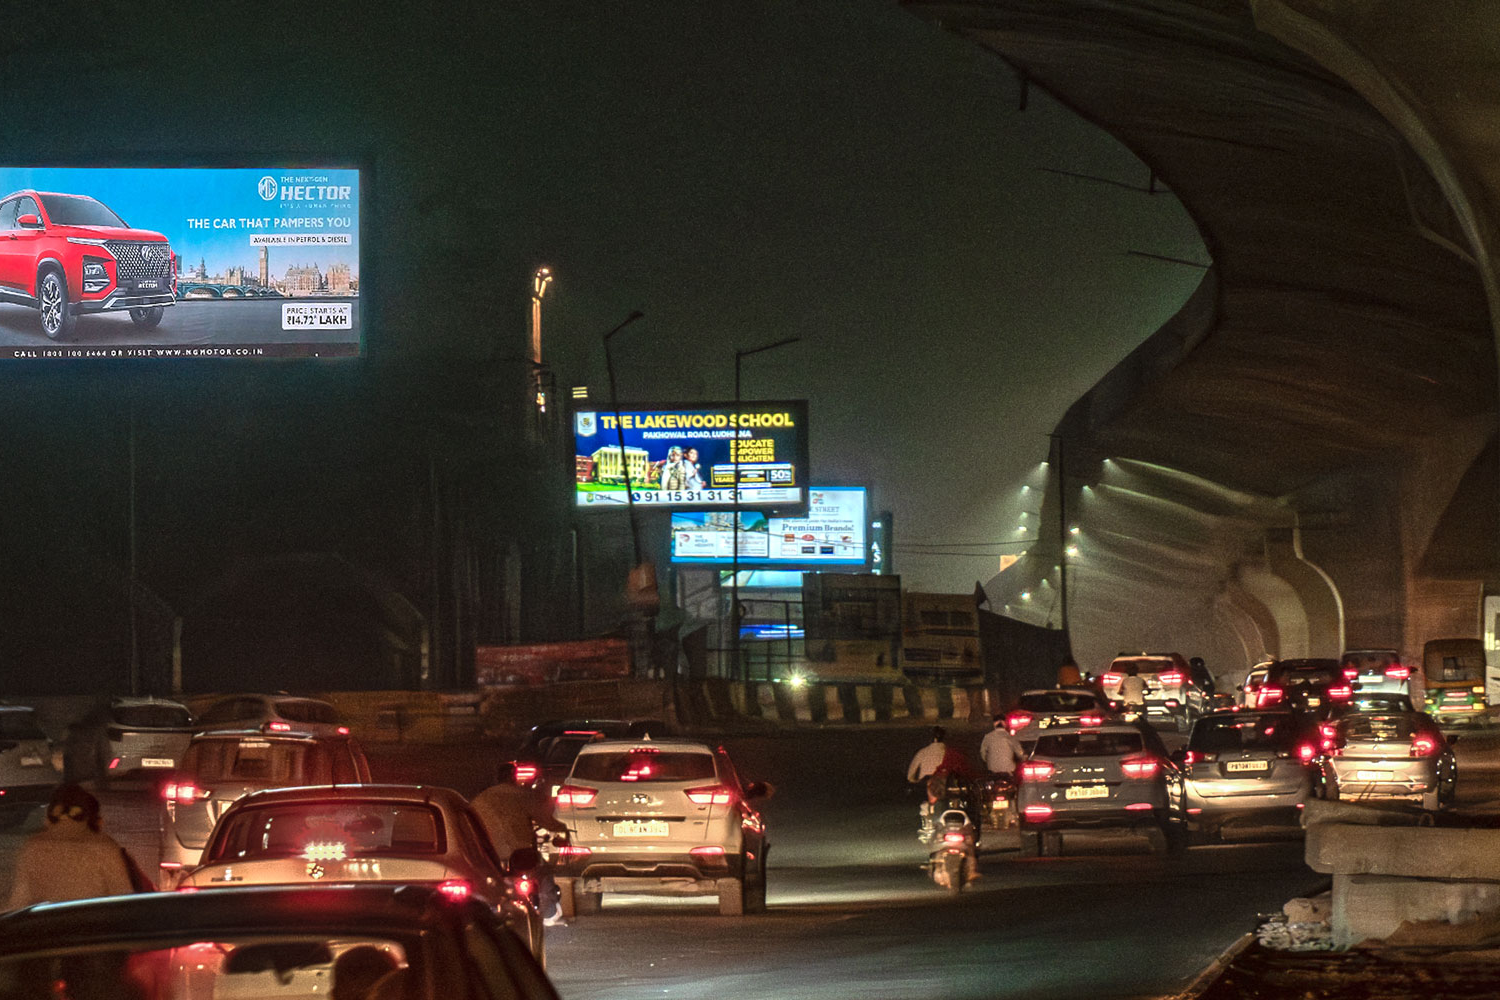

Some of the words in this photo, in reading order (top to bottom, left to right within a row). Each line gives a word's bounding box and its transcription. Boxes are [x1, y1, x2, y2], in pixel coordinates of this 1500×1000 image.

[281, 186, 351, 200] HECTOR
[187, 218, 210, 229] THE
[213, 218, 236, 229] CAR
[239, 218, 270, 228] THAT
[274, 218, 324, 228] PAMPERS
[327, 218, 350, 228] YOU
[320, 316, 346, 324] LAKH
[601, 416, 633, 429] THE
[636, 414, 727, 428] LAKEWOOD
[730, 413, 794, 427] SCHOOL
[645, 492, 659, 501] 91
[667, 492, 682, 501] 15
[687, 491, 701, 501] 31
[708, 491, 722, 500] 31
[728, 491, 742, 500] 31
